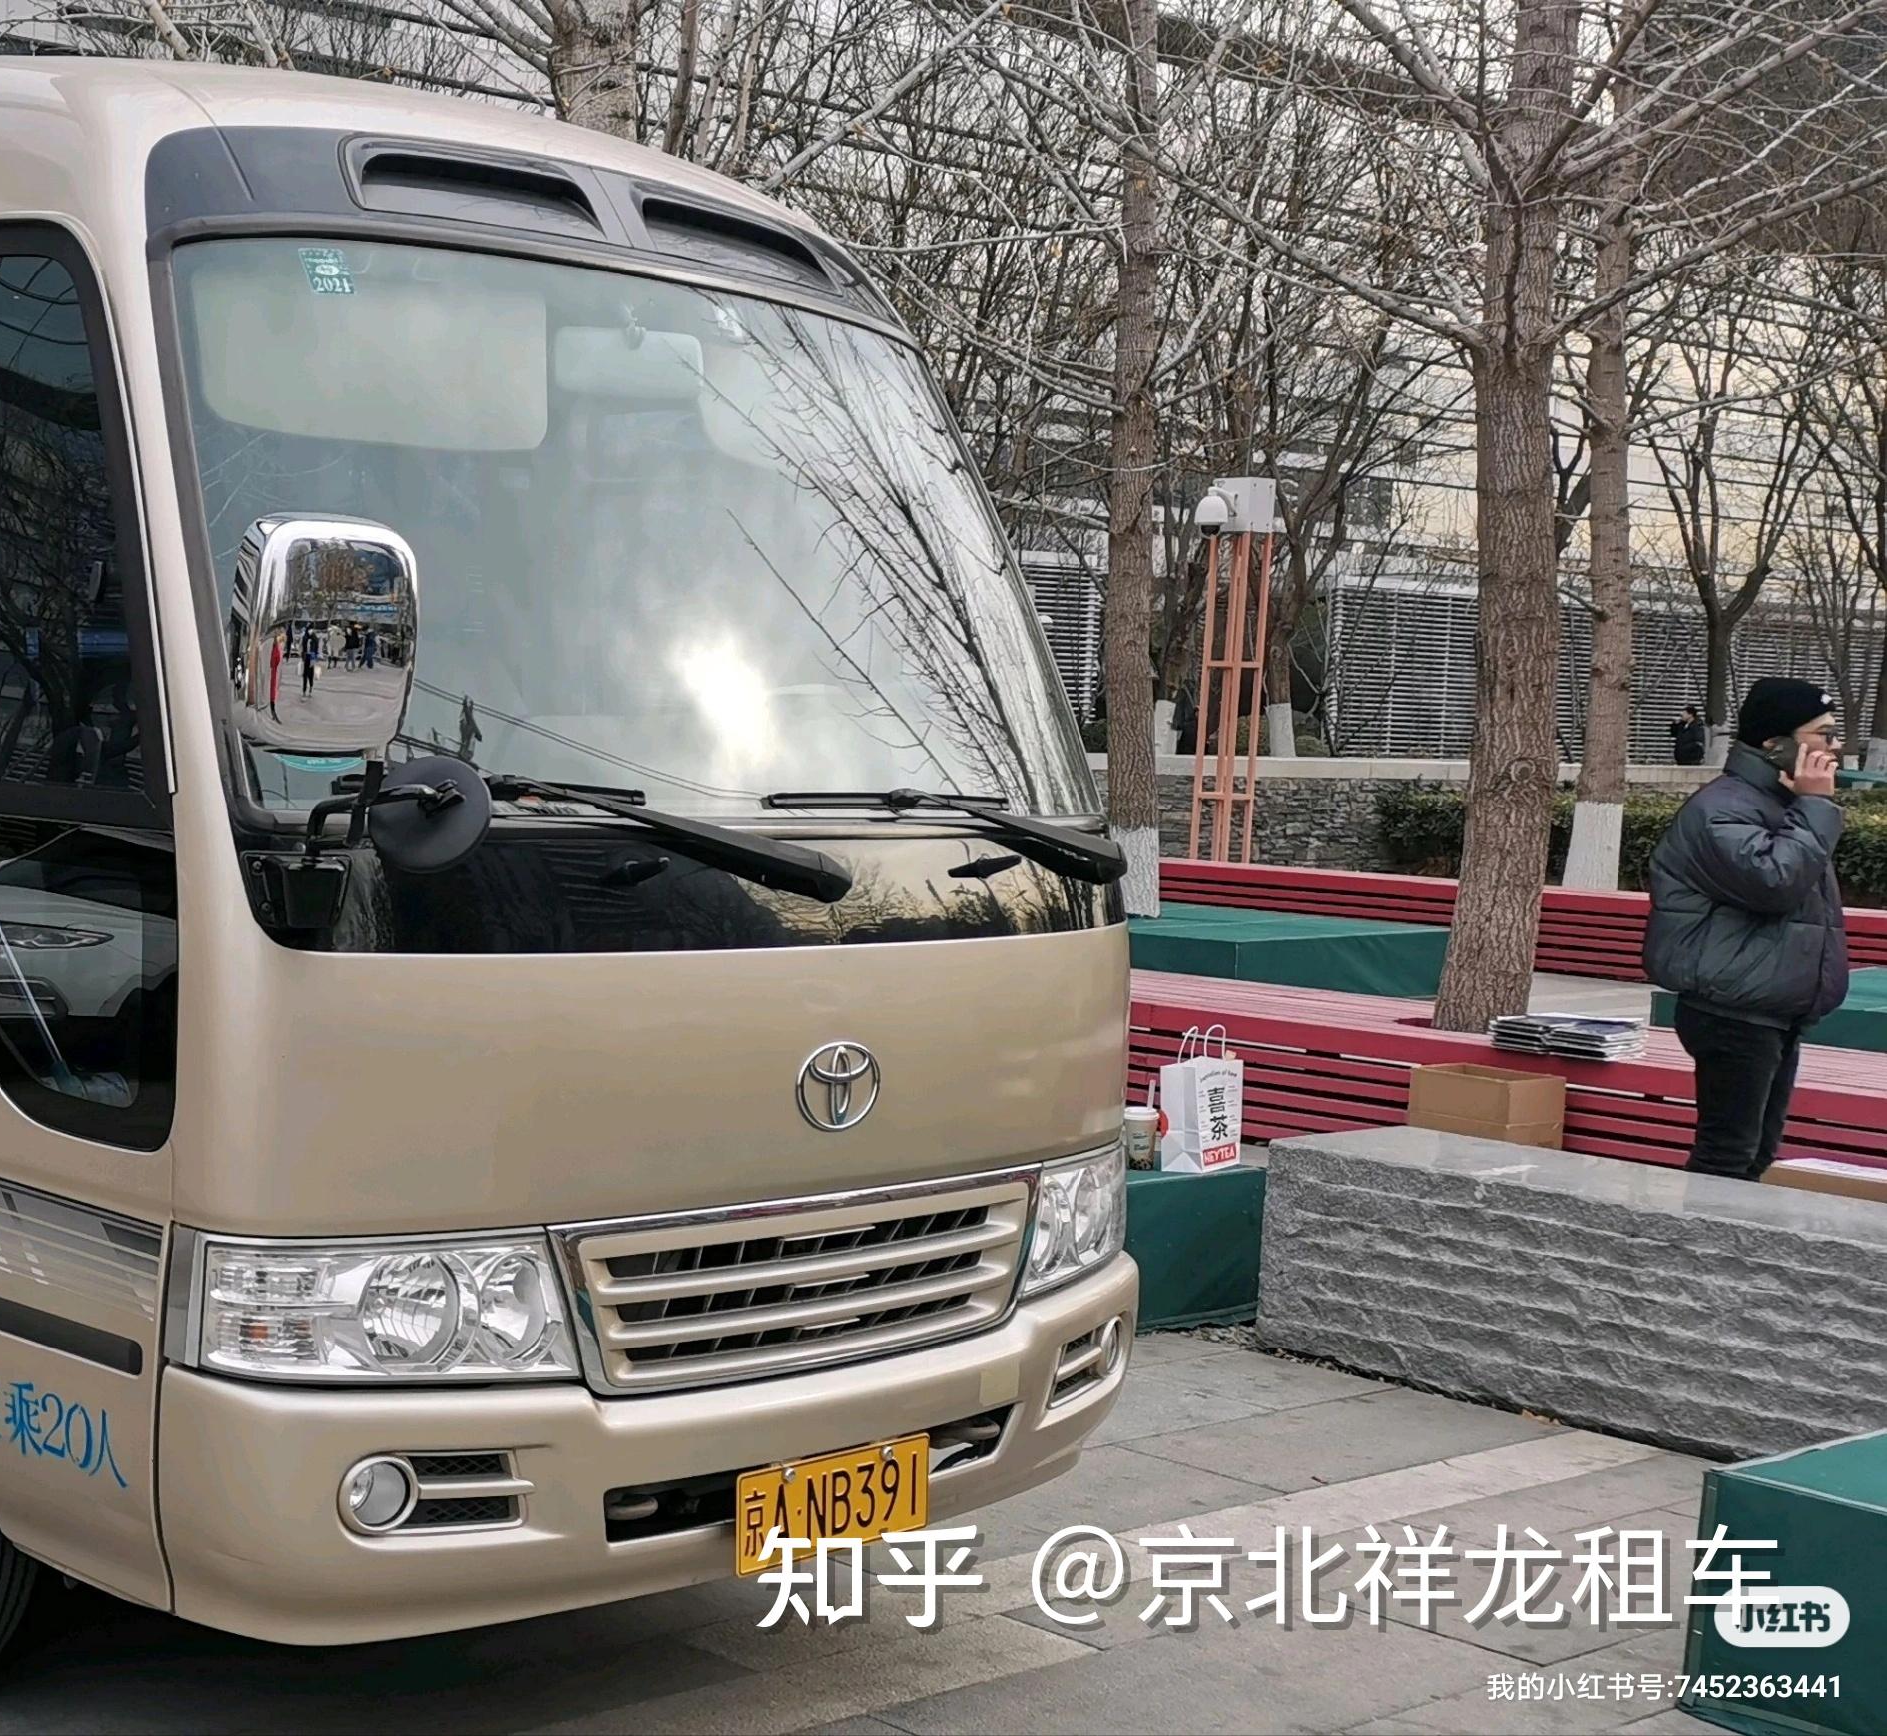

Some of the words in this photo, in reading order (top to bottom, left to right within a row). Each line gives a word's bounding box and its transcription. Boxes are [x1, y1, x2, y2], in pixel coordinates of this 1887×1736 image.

[313, 276, 351, 293] 2021
[1207, 1087, 1228, 1141] 喜茶
[1204, 1147, 1235, 1163] HEYTEA
